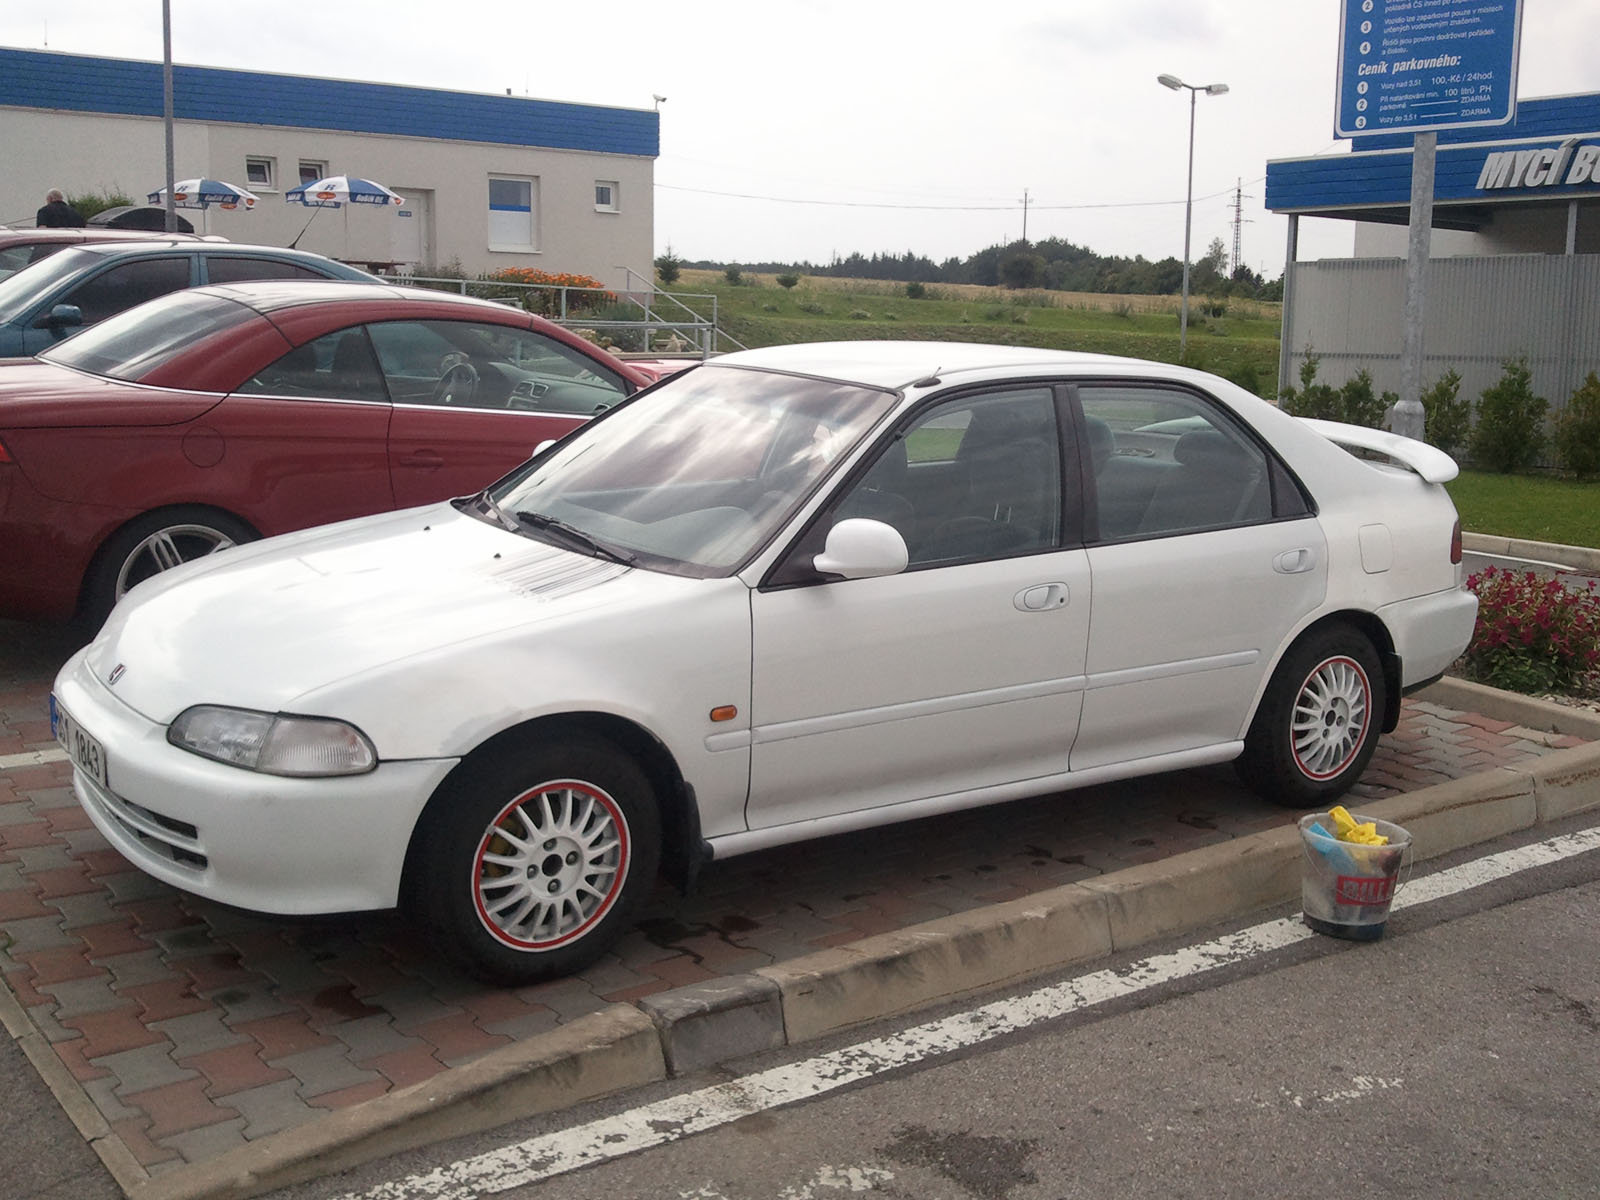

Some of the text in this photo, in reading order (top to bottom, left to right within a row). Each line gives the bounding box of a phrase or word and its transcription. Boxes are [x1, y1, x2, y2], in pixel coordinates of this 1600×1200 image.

[1358, 54, 1462, 76] Ceník parkovného:
[1444, 88, 1458, 97] 100
[1479, 85, 1492, 93] PH
[1460, 94, 1491, 104] ZDARMA
[1460, 107, 1491, 117] ZDARMA
[1475, 138, 1578, 190] MYCÍ
[76, 729, 100, 778] 1843
